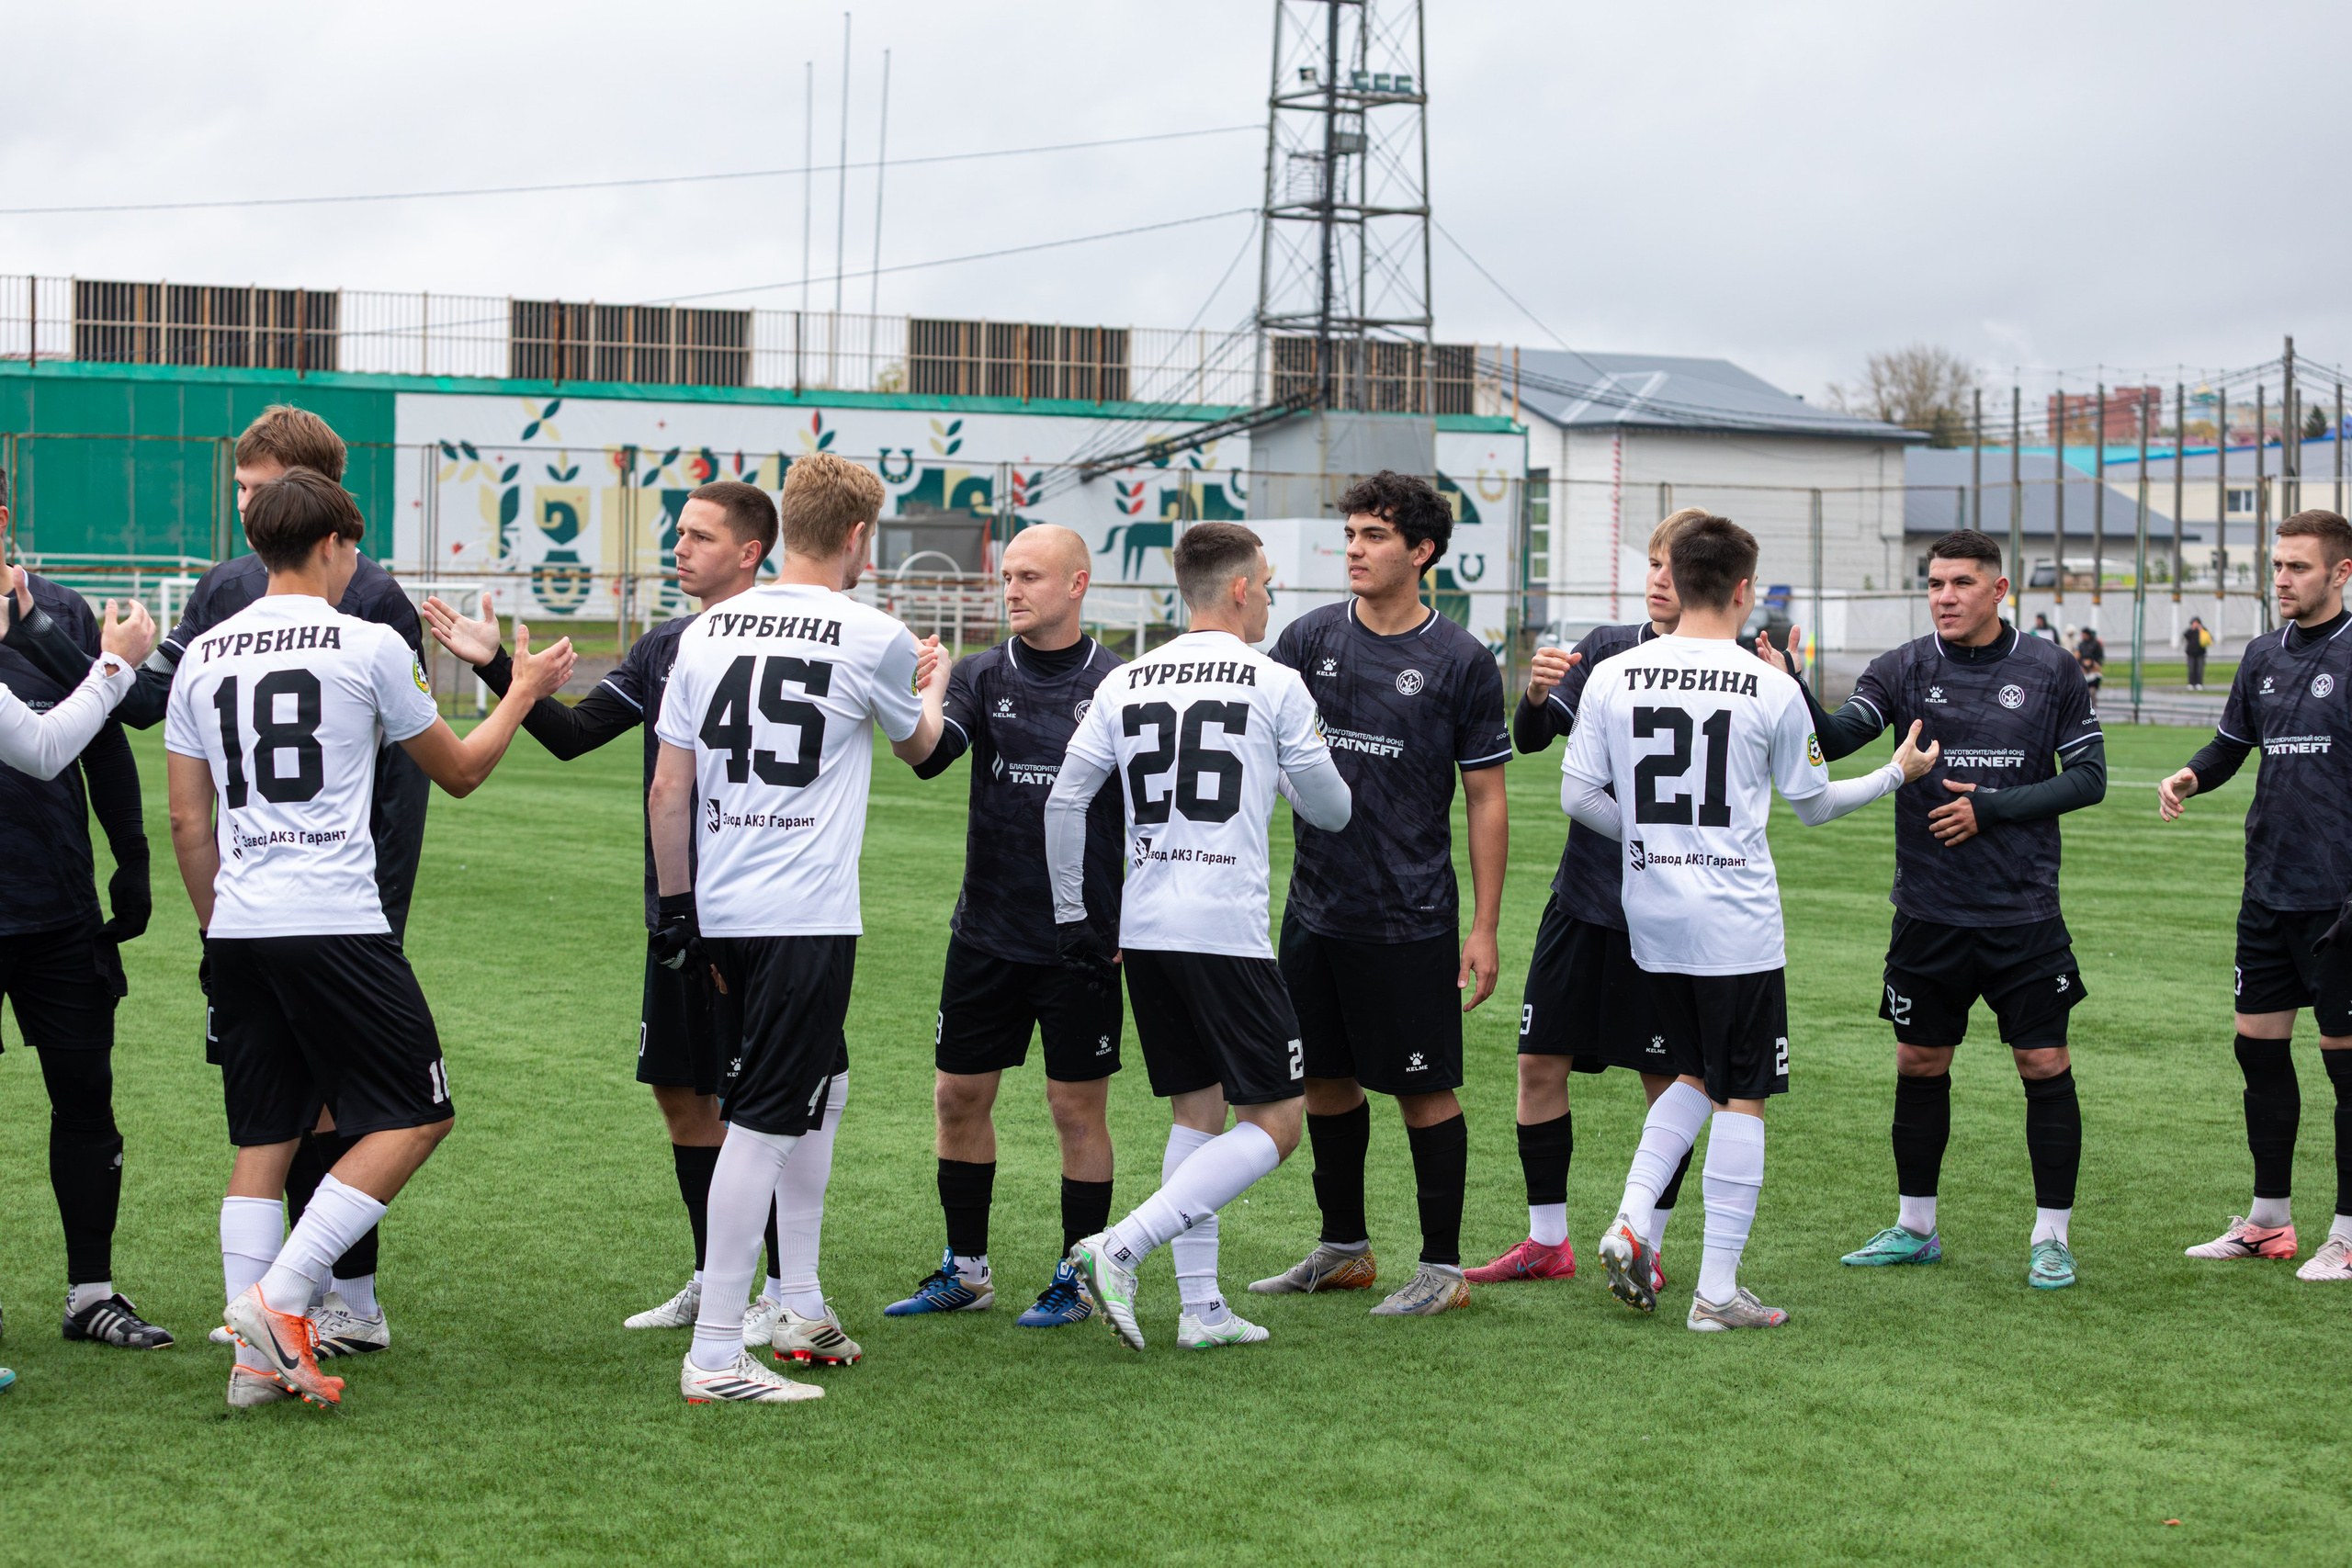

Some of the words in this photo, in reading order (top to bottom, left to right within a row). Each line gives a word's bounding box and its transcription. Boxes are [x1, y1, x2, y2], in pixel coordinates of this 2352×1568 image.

[707, 613, 842, 647] ТУРБИНА
[201, 626, 341, 663] ТУРБИНА
[1128, 661, 1257, 690] ТУРБИНА
[1624, 668, 1758, 698] ТУРБИНА
[698, 655, 833, 788] 45
[213, 669, 324, 809] 18
[1327, 735, 1403, 758] TATNEFT
[1385, 738, 1404, 747] ФОНД
[2265, 742, 2331, 755] TATNEFT
[1122, 699, 1250, 825] 26
[1633, 706, 1732, 828] 21
[1944, 756, 2024, 767] TATNEFT
[744, 814, 765, 828] АКЗ
[769, 815, 815, 830] Гарант
[269, 831, 295, 843] АКЗ
[299, 830, 346, 845] Гарант
[1170, 849, 1193, 862] АКЗ
[1195, 850, 1237, 865] Гарант
[1647, 852, 1682, 866] Завод
[1684, 853, 1704, 865] АКЗ
[1706, 854, 1747, 868] Гарант
[1095, 1047, 1112, 1056] KELME
[1287, 1037, 1304, 1080] 2
